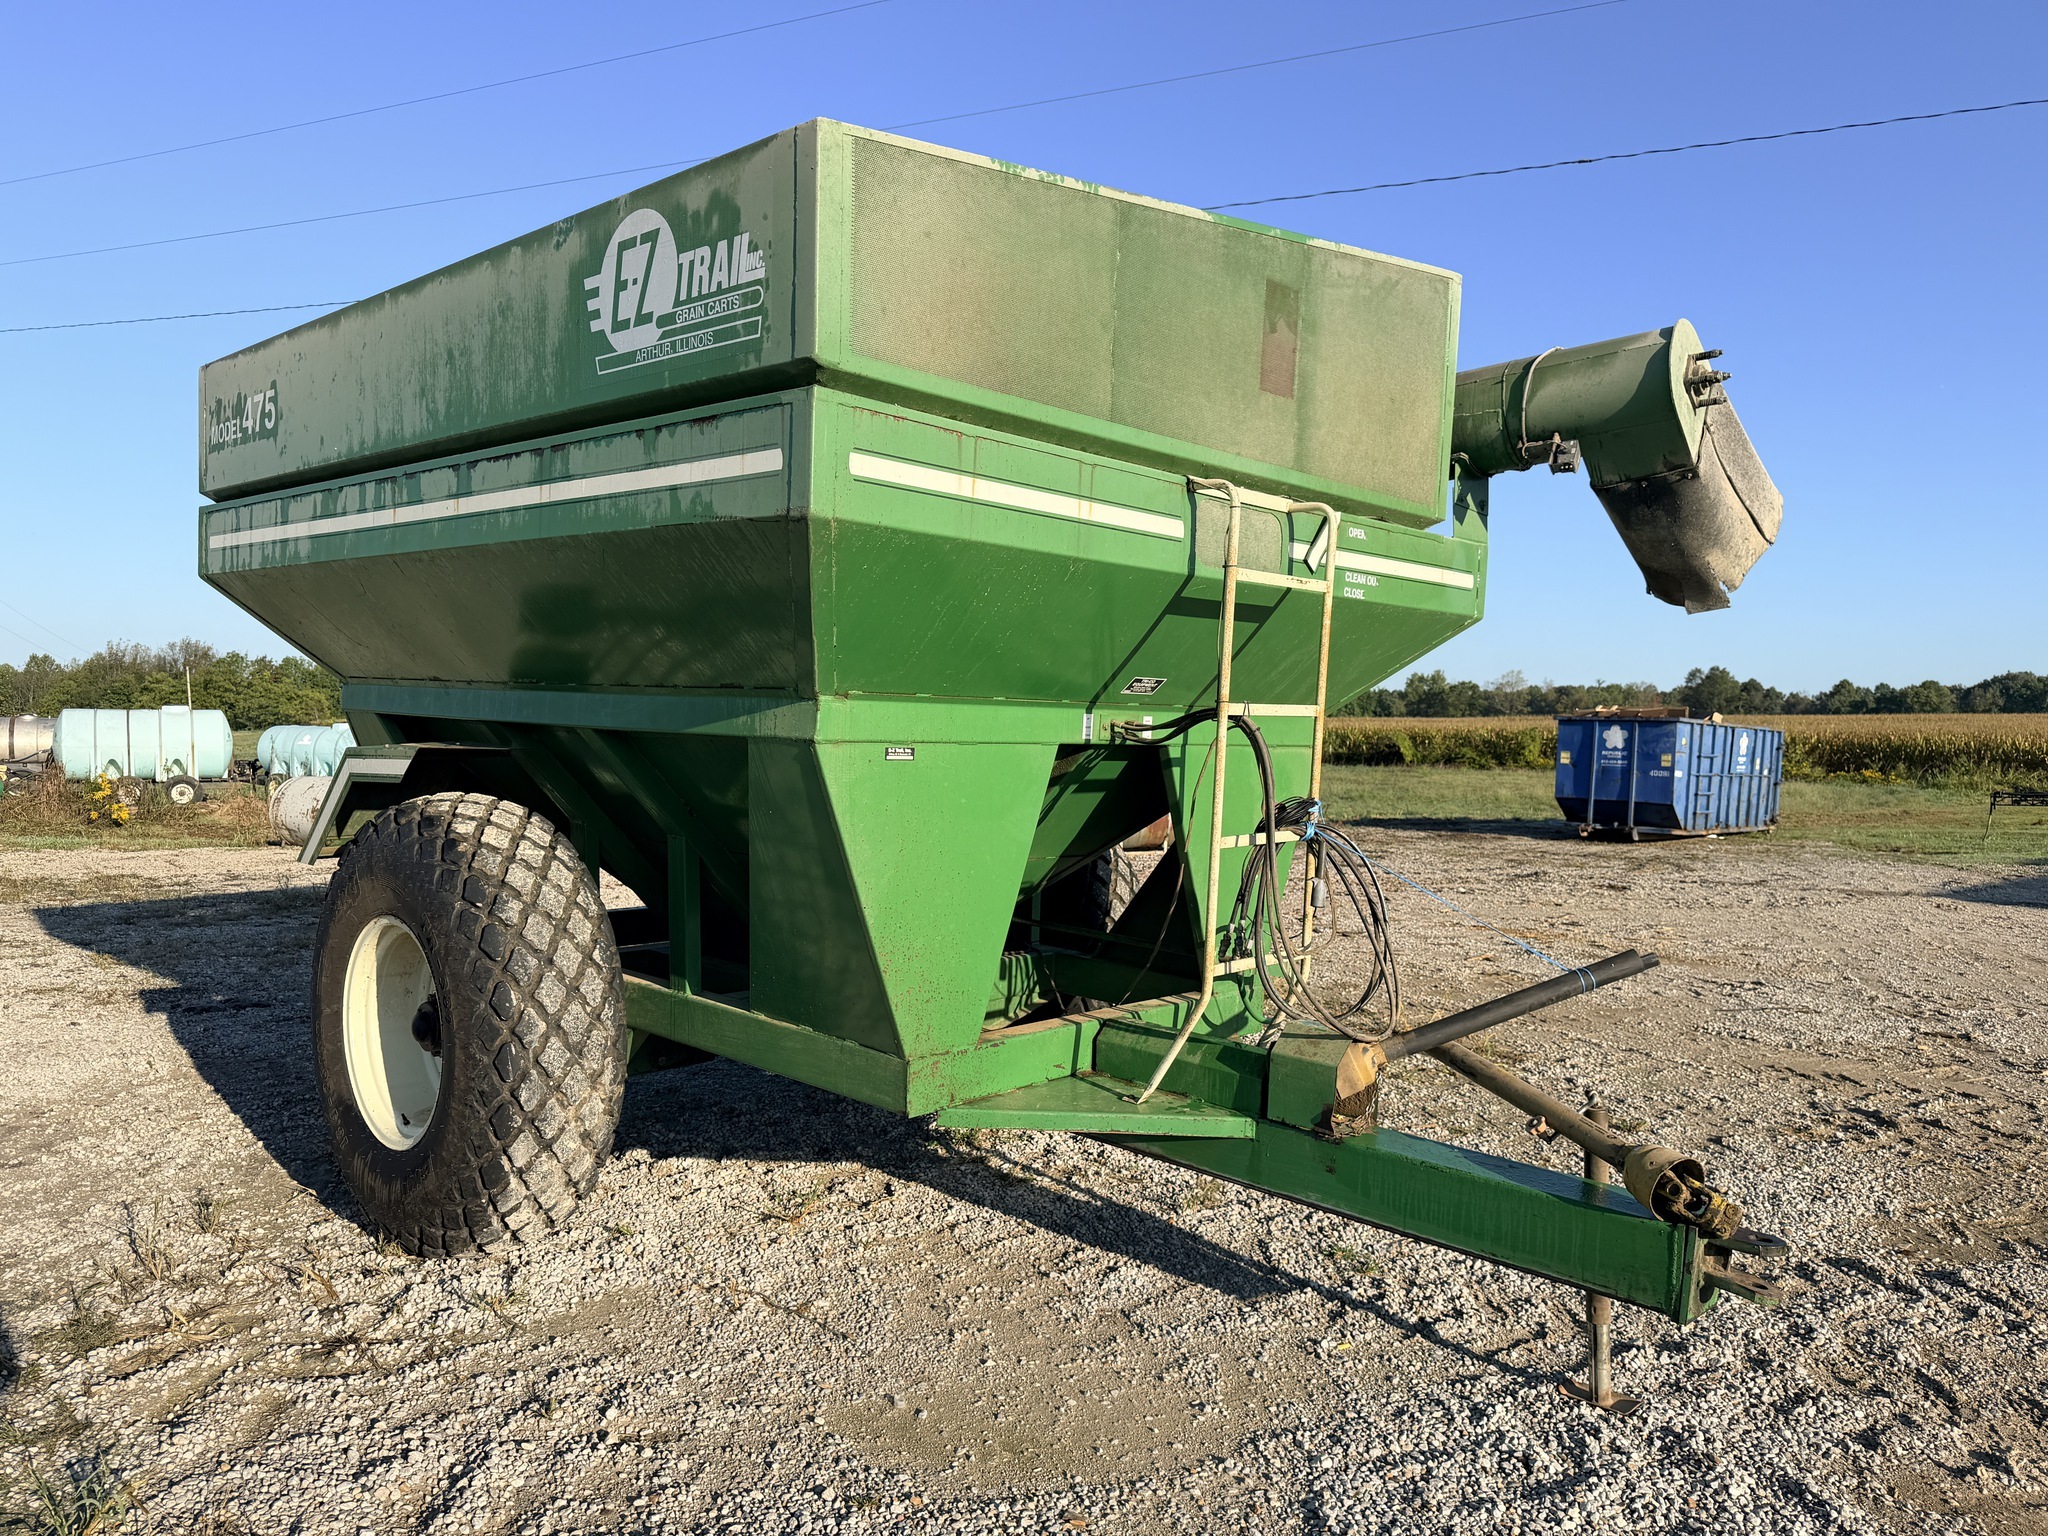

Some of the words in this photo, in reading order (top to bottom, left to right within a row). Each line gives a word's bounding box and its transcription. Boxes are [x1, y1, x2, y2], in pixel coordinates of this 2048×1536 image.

[678, 231, 765, 301] TRAIL
[745, 249, 765, 272] INC.
[675, 305, 704, 324] GRAIN
[707, 295, 740, 316] CARTS
[676, 332, 714, 353] ILLINOIS
[211, 415, 242, 446] MODEL
[242, 389, 276, 435] 475
[1345, 571, 1366, 584] CLEAN
[1367, 576, 1379, 587] OU
